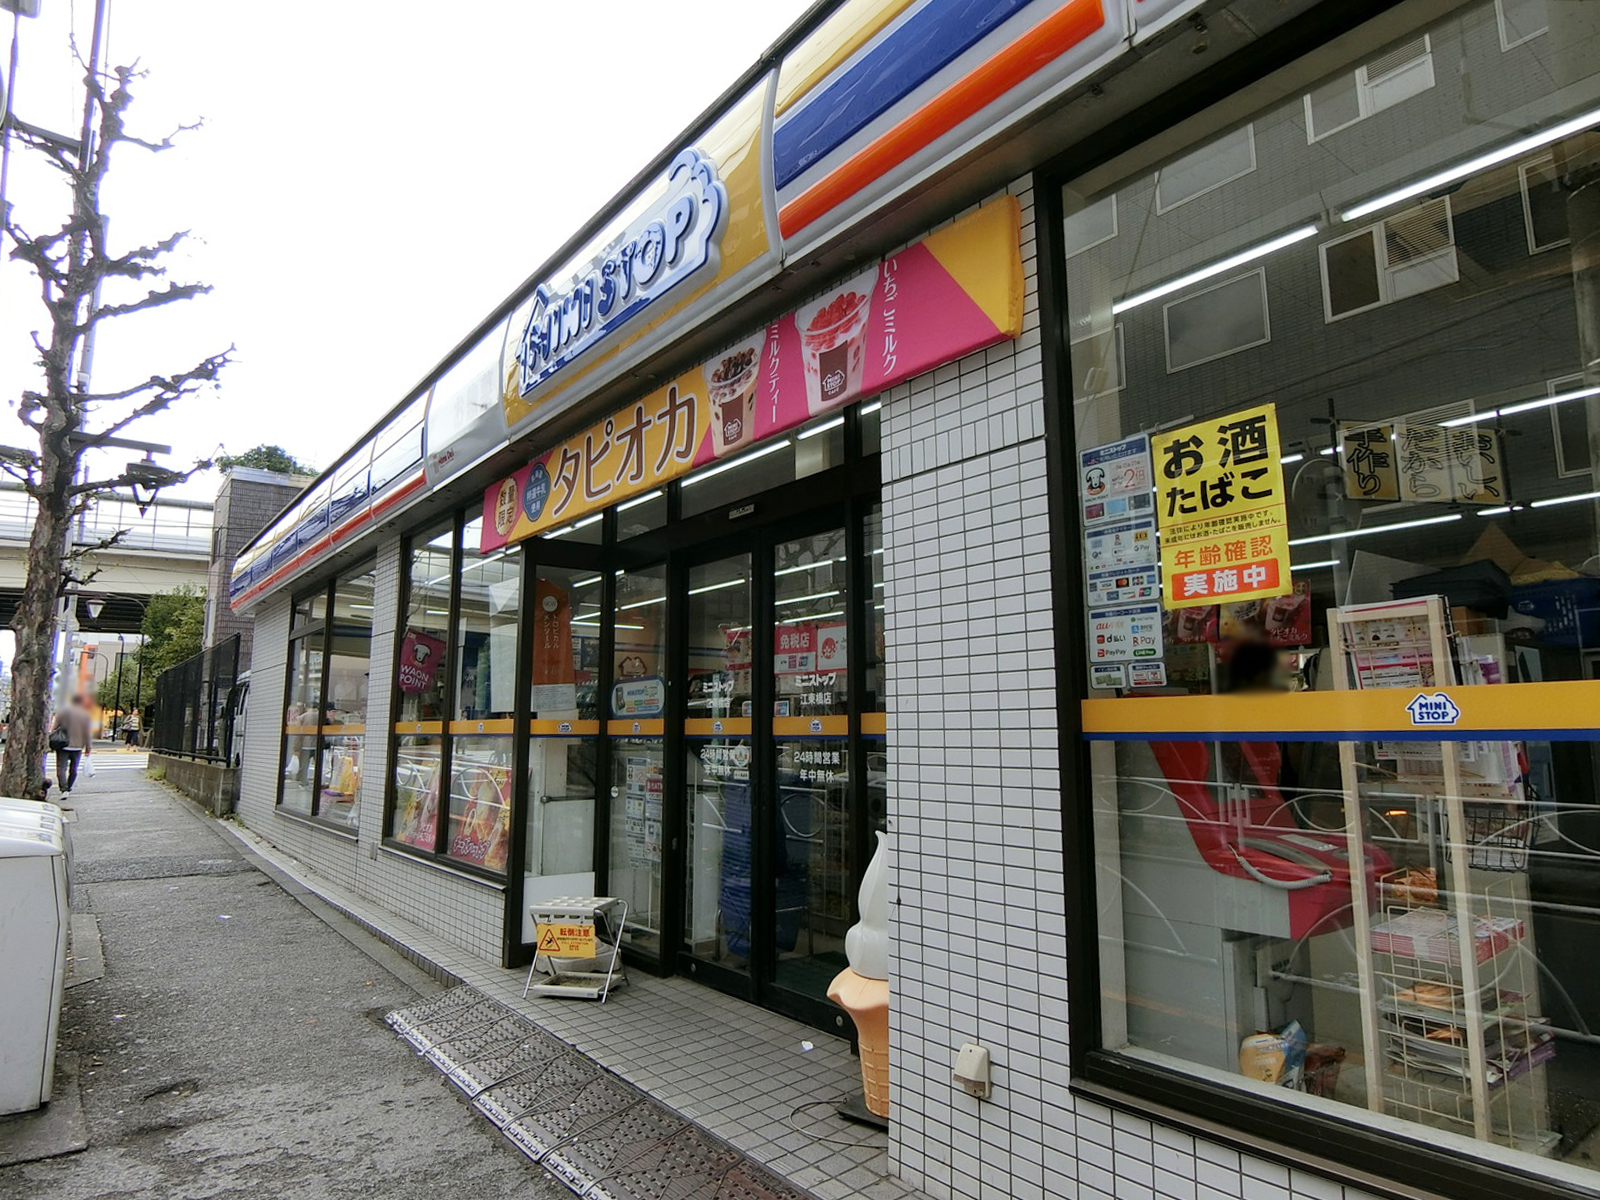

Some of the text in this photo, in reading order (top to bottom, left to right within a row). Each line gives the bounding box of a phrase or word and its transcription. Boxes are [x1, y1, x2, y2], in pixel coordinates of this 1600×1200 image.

[882, 259, 898, 376] いちごミルク
[769, 324, 780, 423] ミルクティー
[552, 385, 697, 517] タピオカ
[1163, 415, 1268, 479] お酒
[1345, 427, 1390, 496] 手作り
[1166, 467, 1272, 517] たばこ
[1174, 534, 1273, 569] 年齢確認
[1183, 564, 1266, 597] 実施中
[1106, 649, 1127, 657] PayPay
[400, 674, 427, 690] POINT
[401, 664, 430, 682] WAON
[795, 672, 837, 687] ミニストップ
[800, 692, 832, 705] 江東橋店
[1418, 701, 1447, 711] MINI
[1418, 711, 1449, 721] STOP
[794, 751, 840, 764] 24時間営業
[800, 769, 834, 782] 年中無休
